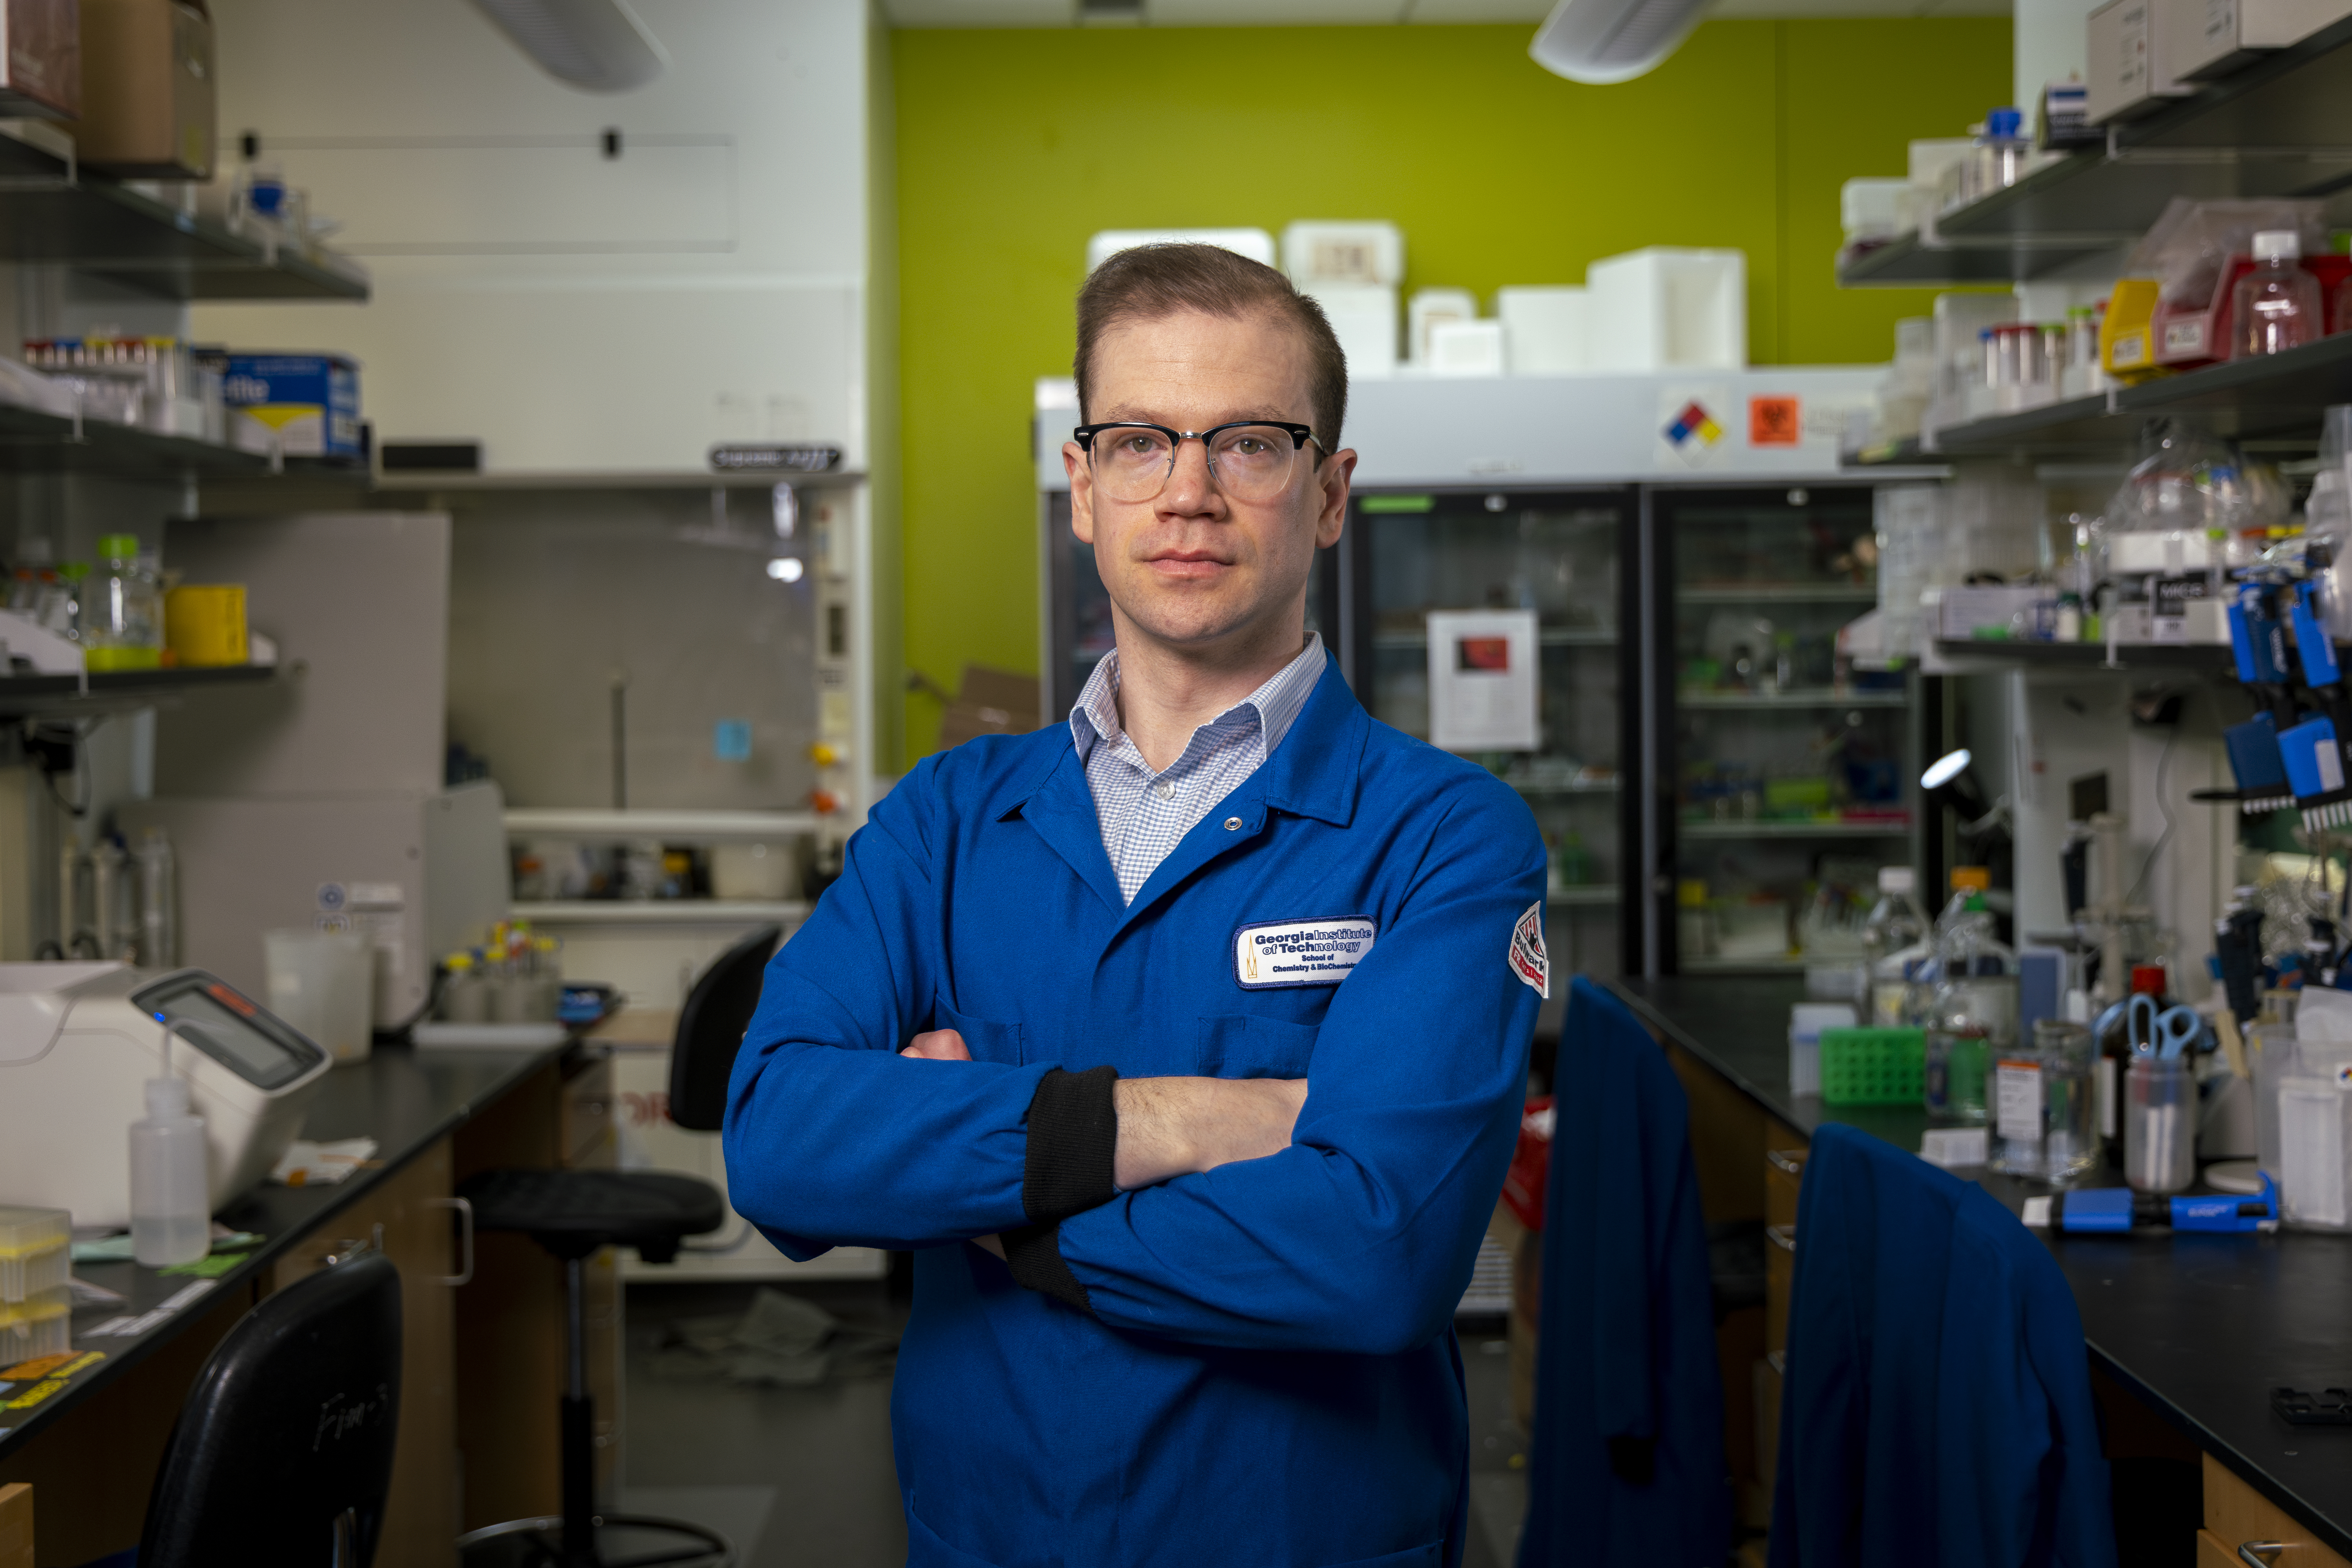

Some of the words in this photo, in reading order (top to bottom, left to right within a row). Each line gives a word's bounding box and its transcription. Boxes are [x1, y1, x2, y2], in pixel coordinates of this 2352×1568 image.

[1262, 944, 1278, 955] of
[1279, 941, 1361, 953] Technology
[1514, 930, 1544, 974] Bulwark
[1514, 949, 1521, 964] FR
[1272, 964, 1309, 973] Chemistry
[1317, 962, 1357, 970] BioChemistr
